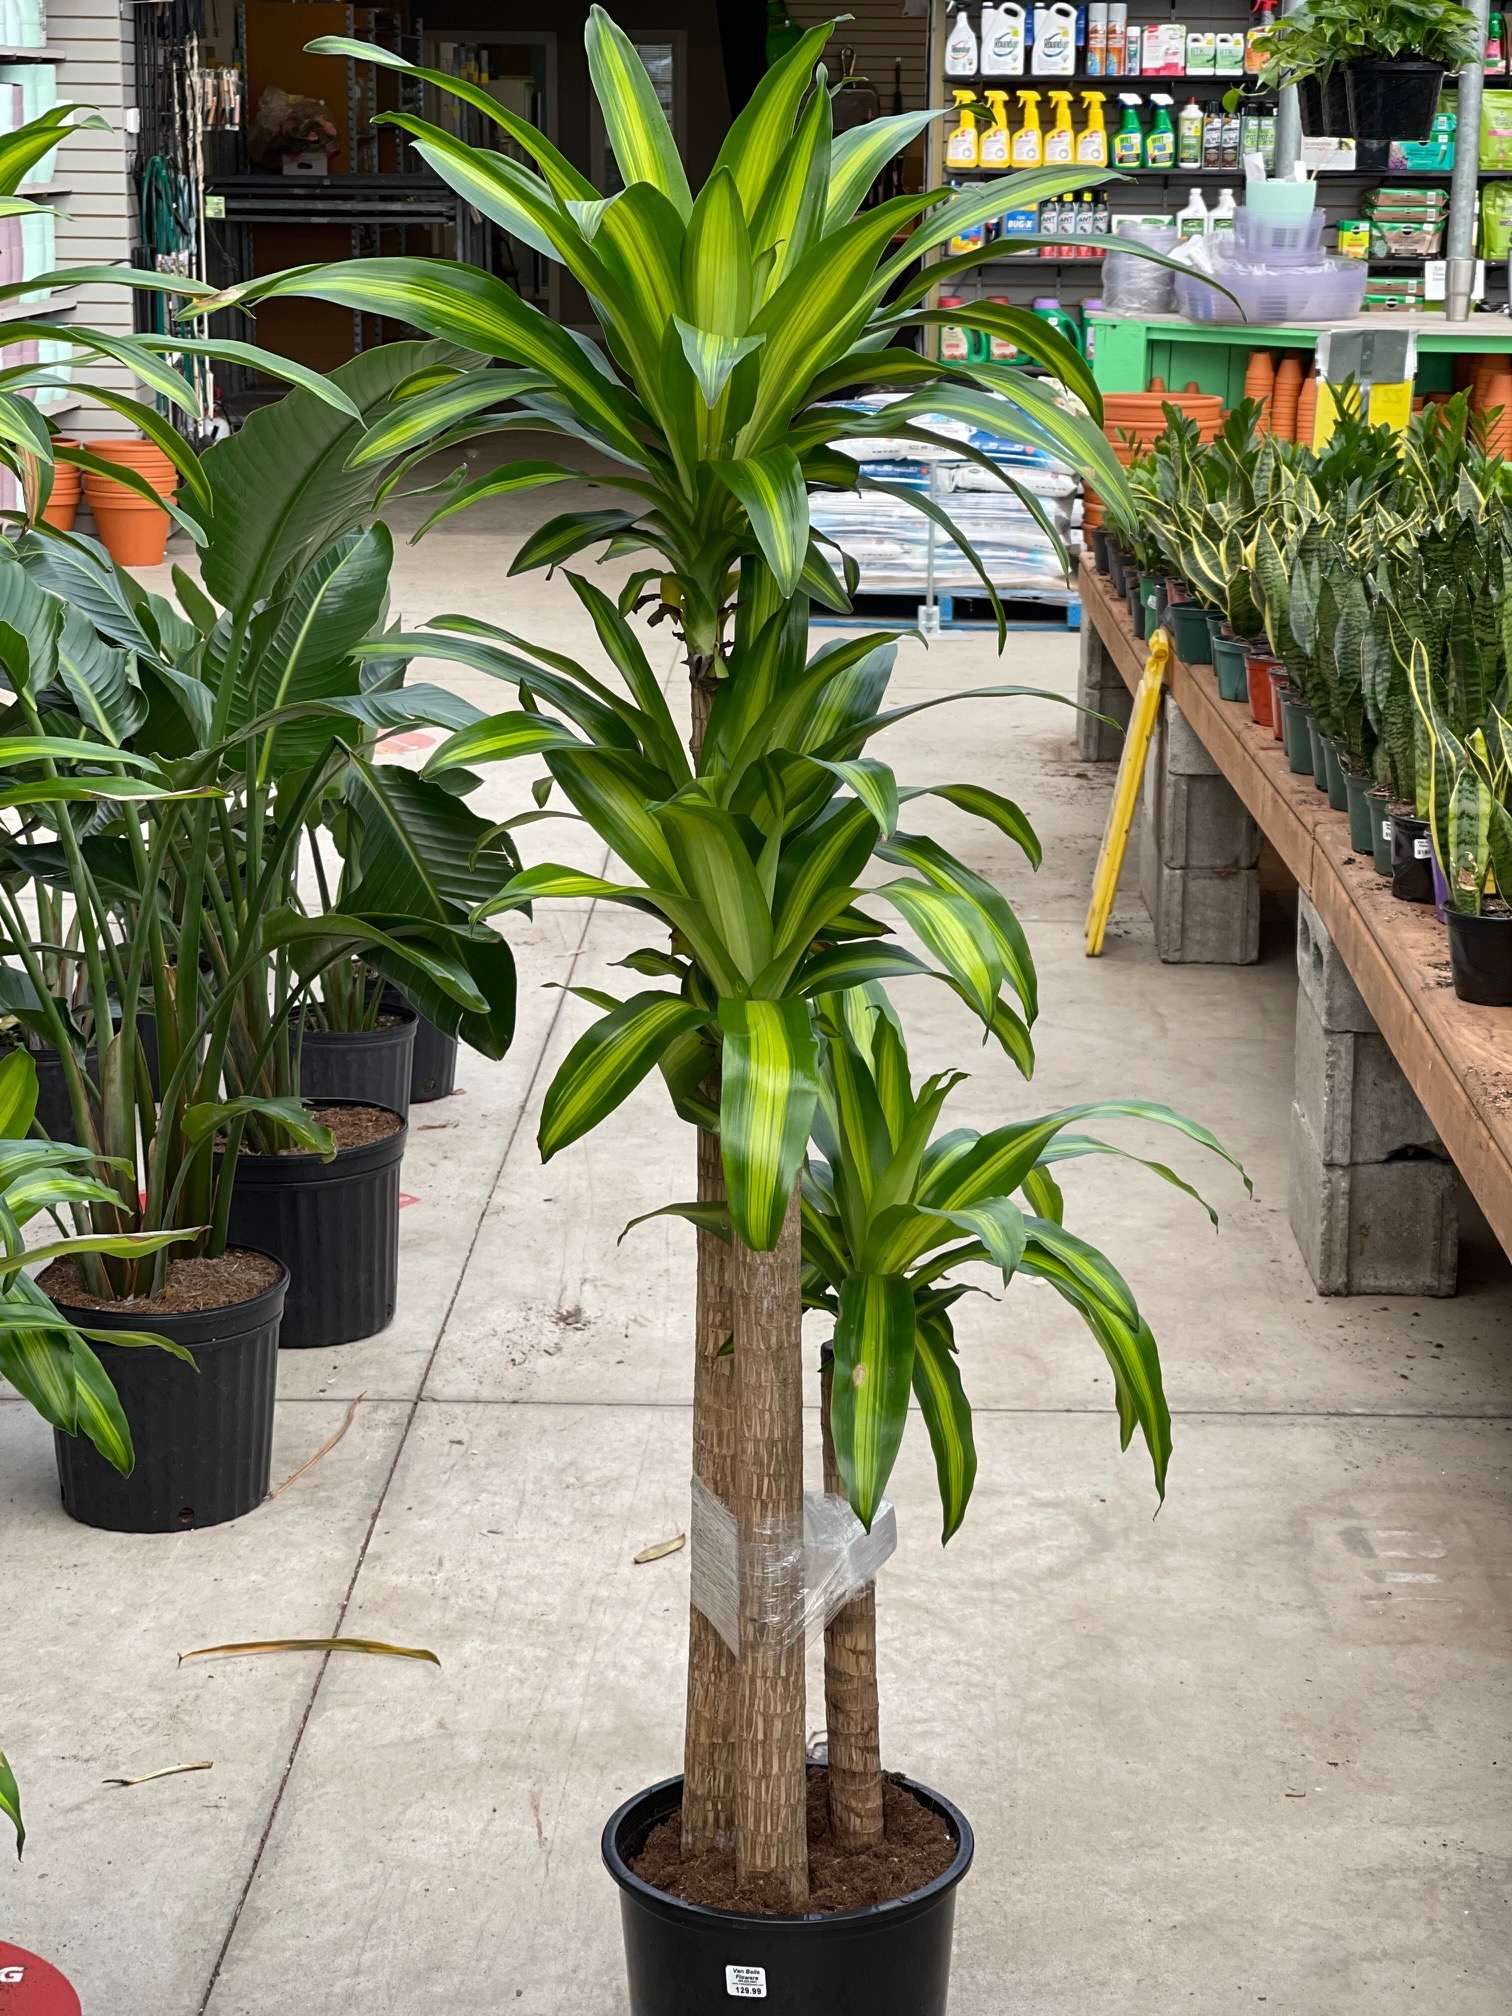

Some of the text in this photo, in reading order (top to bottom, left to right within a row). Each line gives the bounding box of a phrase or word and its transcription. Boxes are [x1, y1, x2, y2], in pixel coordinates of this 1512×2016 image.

[994, 37, 1019, 48] Roundup
[1043, 37, 1070, 49] Roundup
[1190, 47, 1204, 55] BTK
[1041, 215, 1056, 223] ANT
[1060, 215, 1073, 223] ANT
[1077, 215, 1092, 223] ANT
[1094, 215, 1107, 223] ANT
[1007, 219, 1033, 228] BUG-X
[735, 1986, 762, 1995] 129.99
